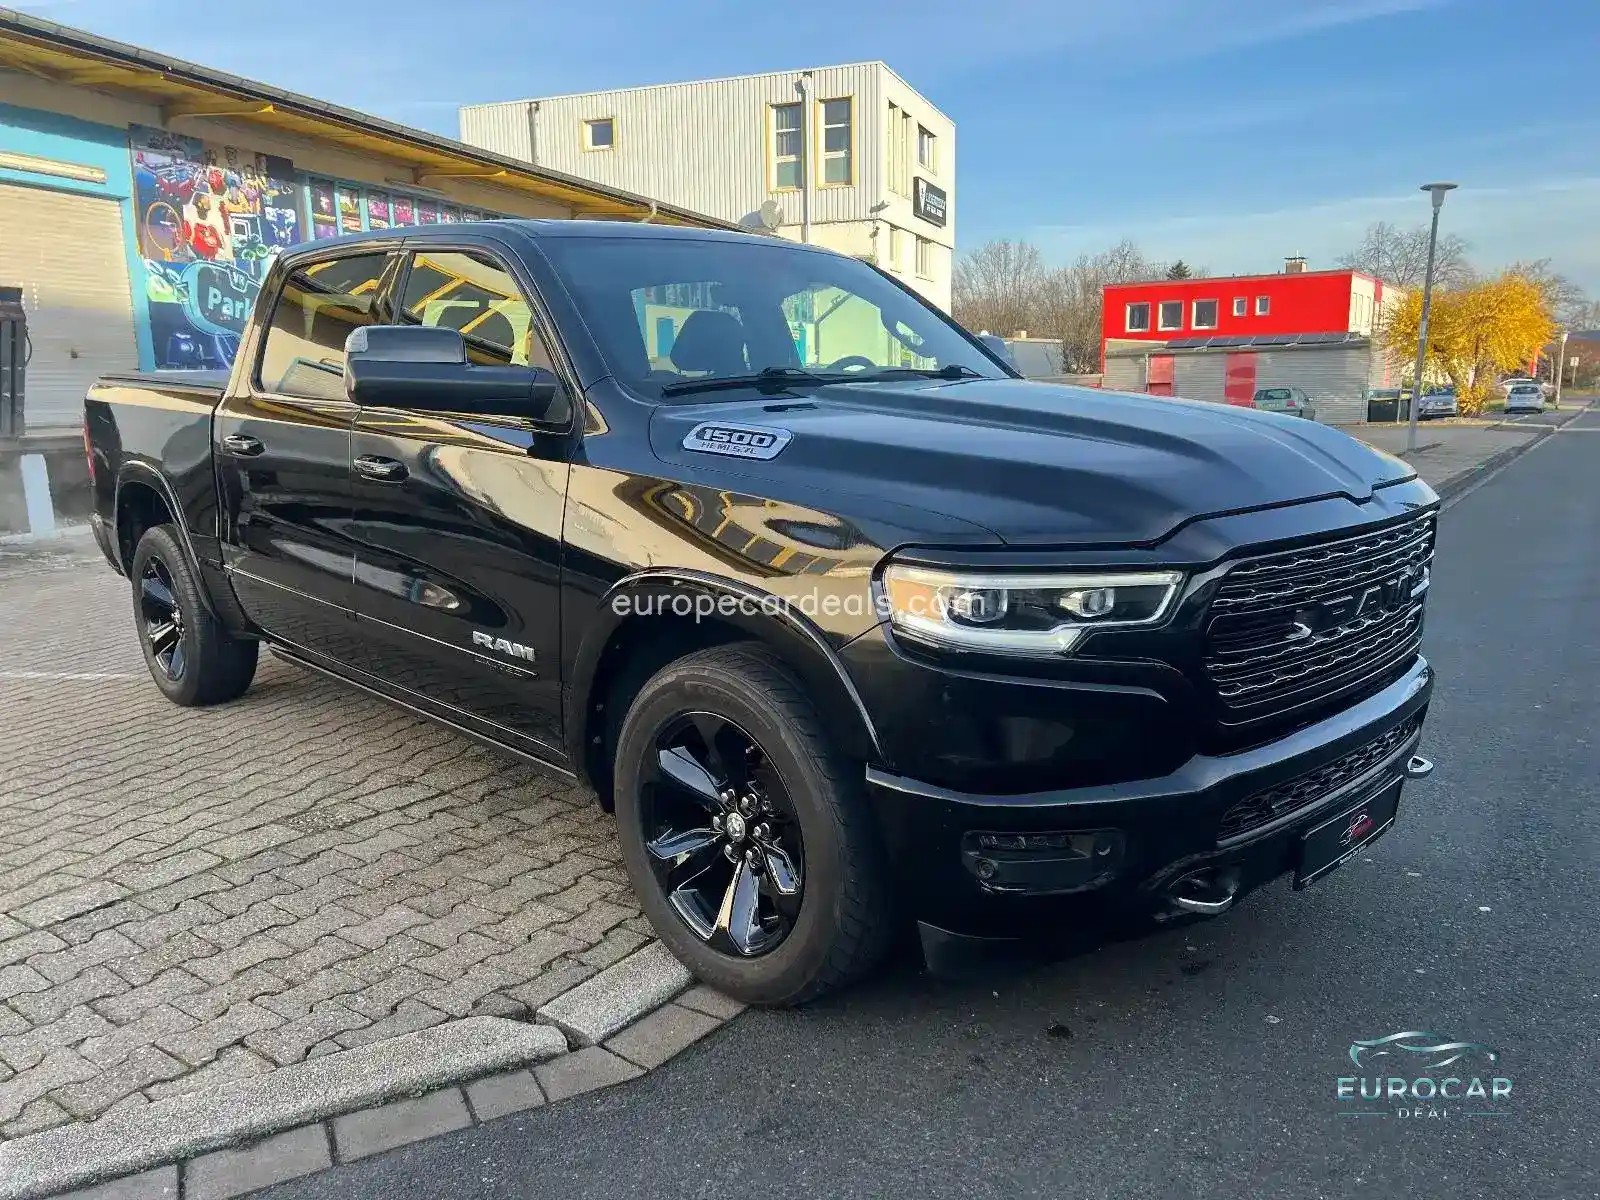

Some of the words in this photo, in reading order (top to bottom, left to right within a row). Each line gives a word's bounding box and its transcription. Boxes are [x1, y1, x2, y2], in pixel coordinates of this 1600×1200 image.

[703, 428, 773, 447] 1500
[701, 441, 730, 451] HEMI
[732, 445, 757, 455] 5.7L
[472, 630, 536, 662] RAM
